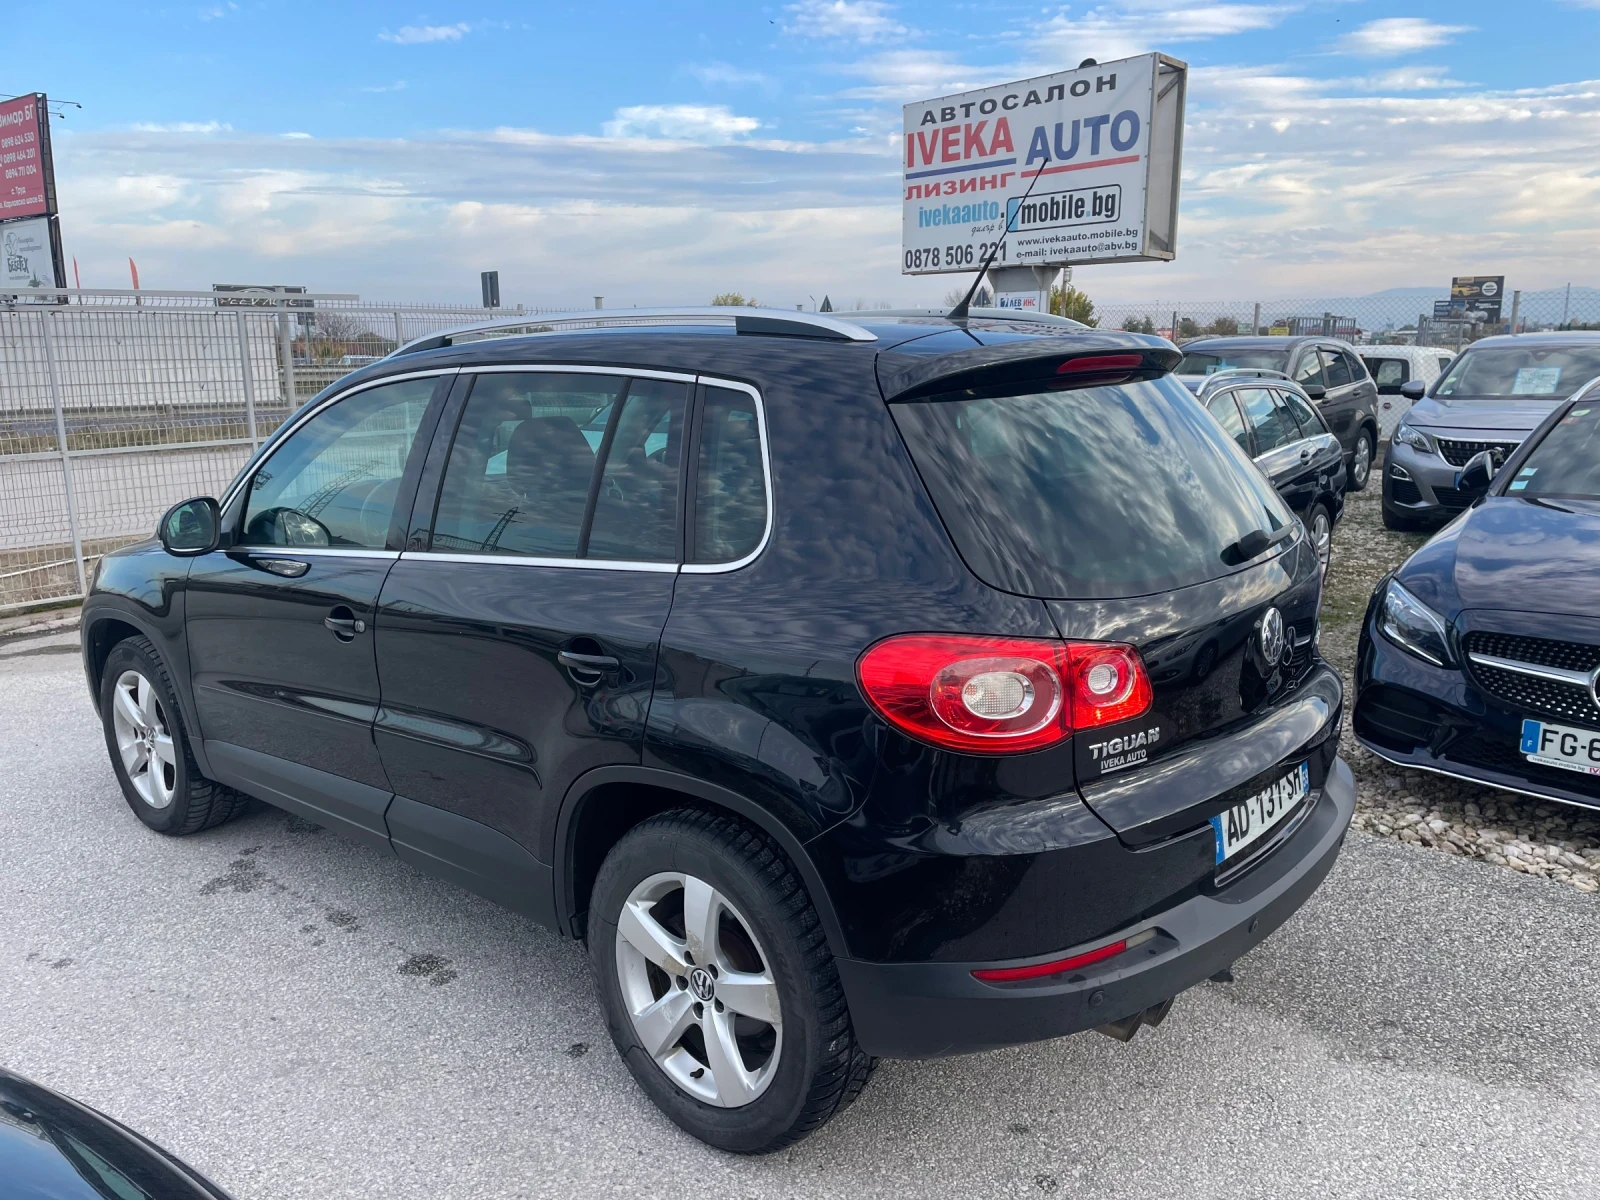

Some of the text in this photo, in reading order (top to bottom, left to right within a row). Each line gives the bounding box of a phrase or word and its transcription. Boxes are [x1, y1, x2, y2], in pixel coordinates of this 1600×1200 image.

[920, 73, 1117, 126] АВТОСАЛОН
[907, 109, 1140, 168] IVEKA AUTO
[905, 171, 1016, 200] ЛИЗИНГ
[1021, 190, 1116, 225] mobile.bg
[1016, 241, 1138, 259] e-mail: ivekaauto@abv.bg
[1017, 228, 1138, 247] www.ivekaauto.mobile.bg
[905, 240, 1007, 269] 0878 506 221
[1088, 727, 1160, 760] TIGUAN
[1100, 749, 1147, 770] IVEKA AUTO
